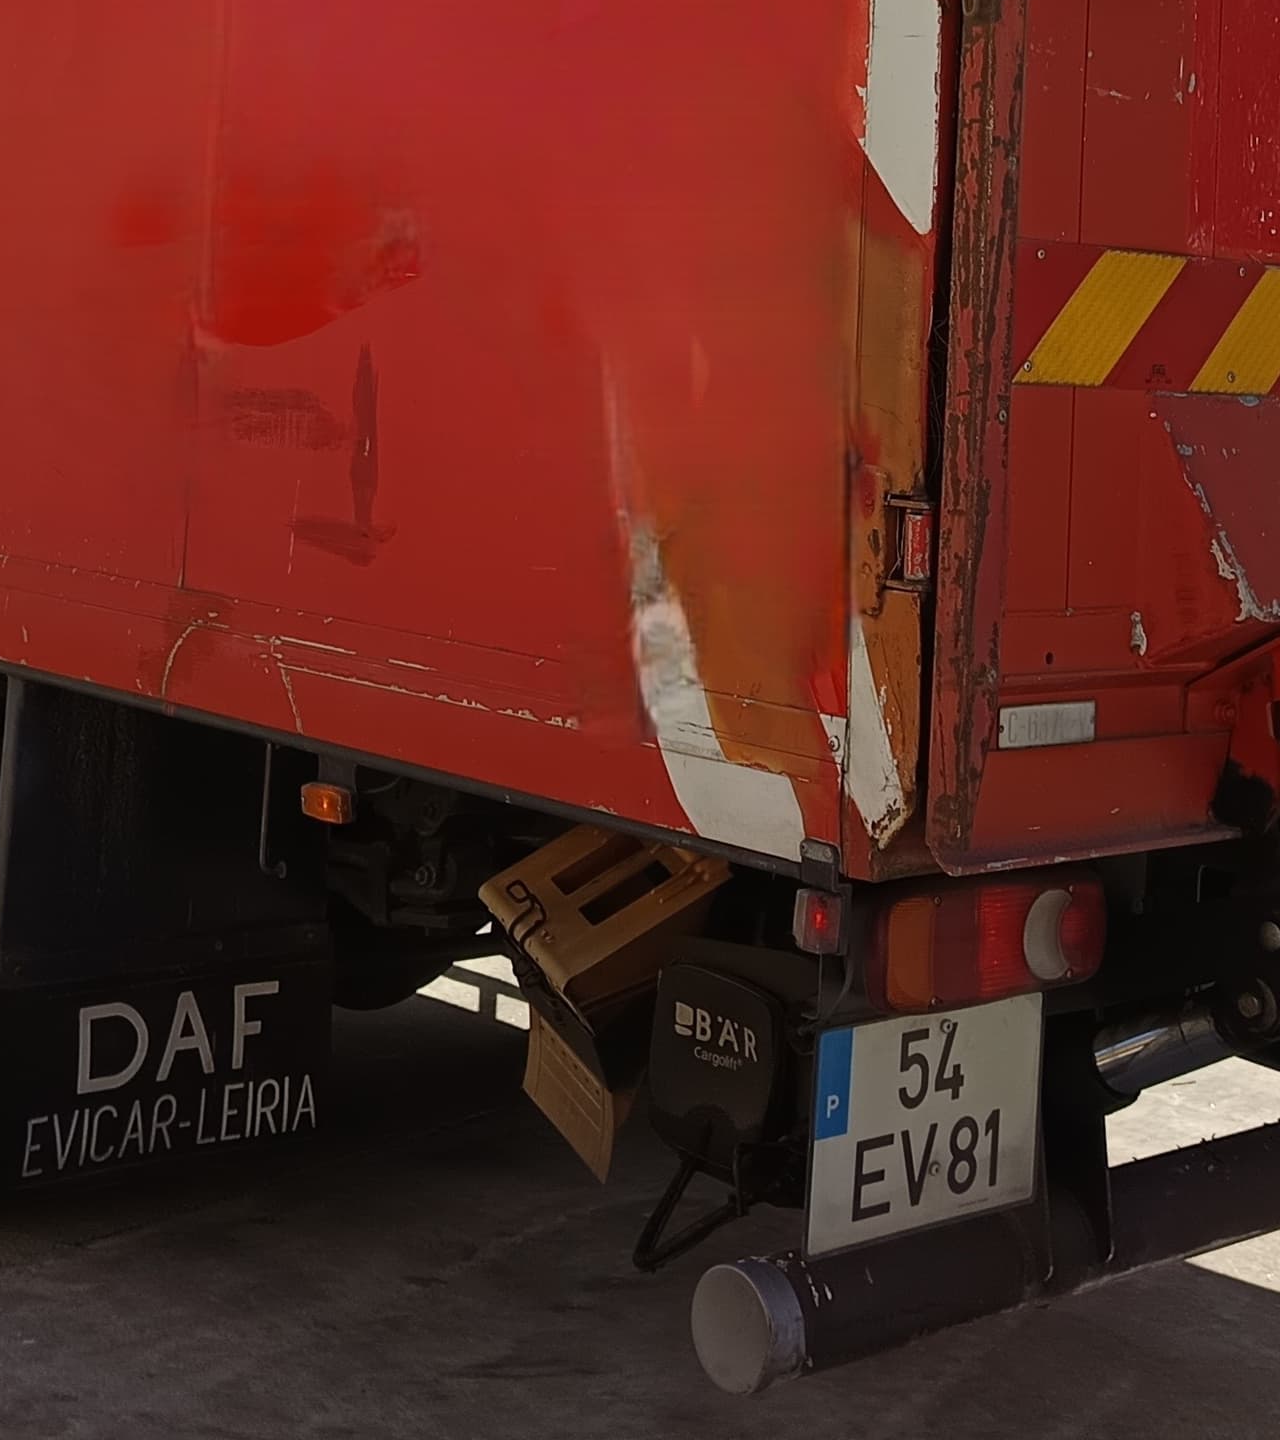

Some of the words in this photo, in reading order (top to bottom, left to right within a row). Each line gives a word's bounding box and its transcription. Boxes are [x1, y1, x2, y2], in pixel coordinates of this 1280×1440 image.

[77, 980, 280, 1095] DAF
[696, 1008, 758, 1062] BÄR
[897, 1022, 965, 1110] 54
[22, 1073, 317, 1177] EVICAR-LEIRIA
[826, 1095, 839, 1118] P
